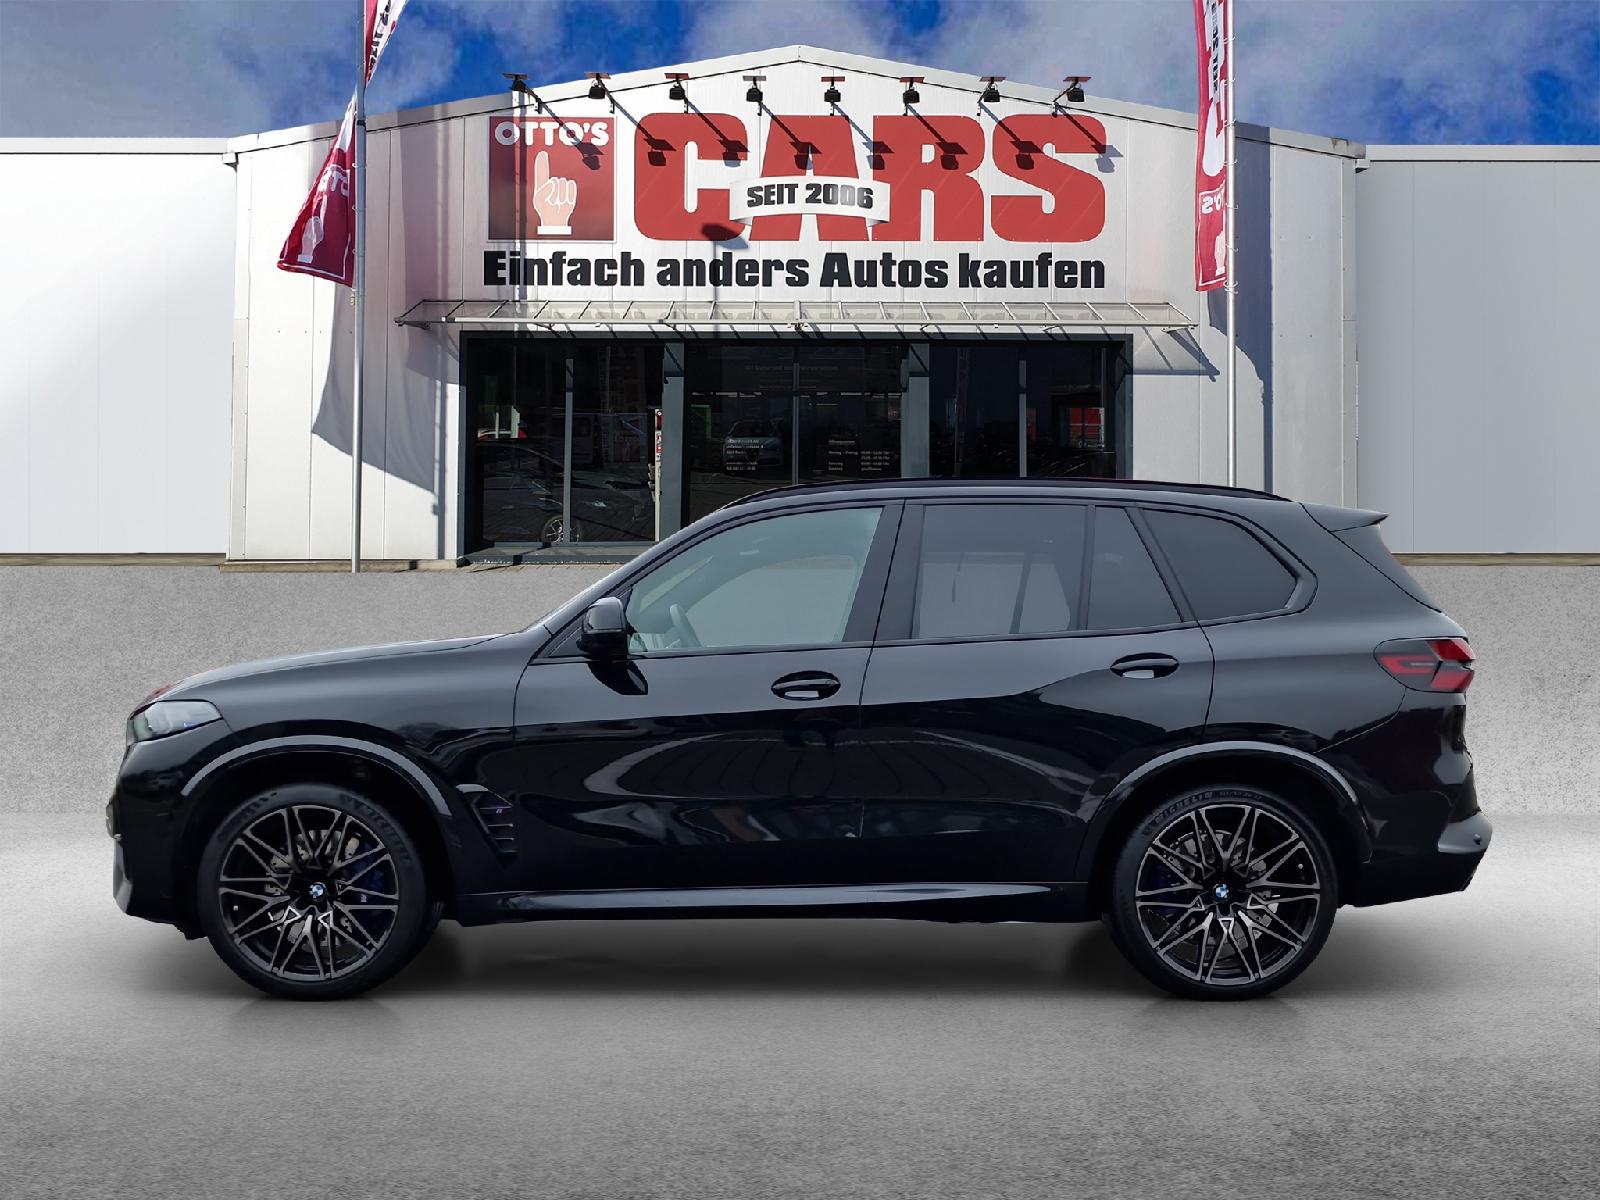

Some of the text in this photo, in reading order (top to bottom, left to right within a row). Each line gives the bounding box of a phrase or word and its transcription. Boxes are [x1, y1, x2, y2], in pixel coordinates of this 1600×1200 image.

[495, 121, 610, 146] OTTO'S
[634, 113, 1107, 242] CARS
[746, 183, 874, 209] SEIT 2006
[483, 251, 1106, 288] Einfach anders Autos kaufen
